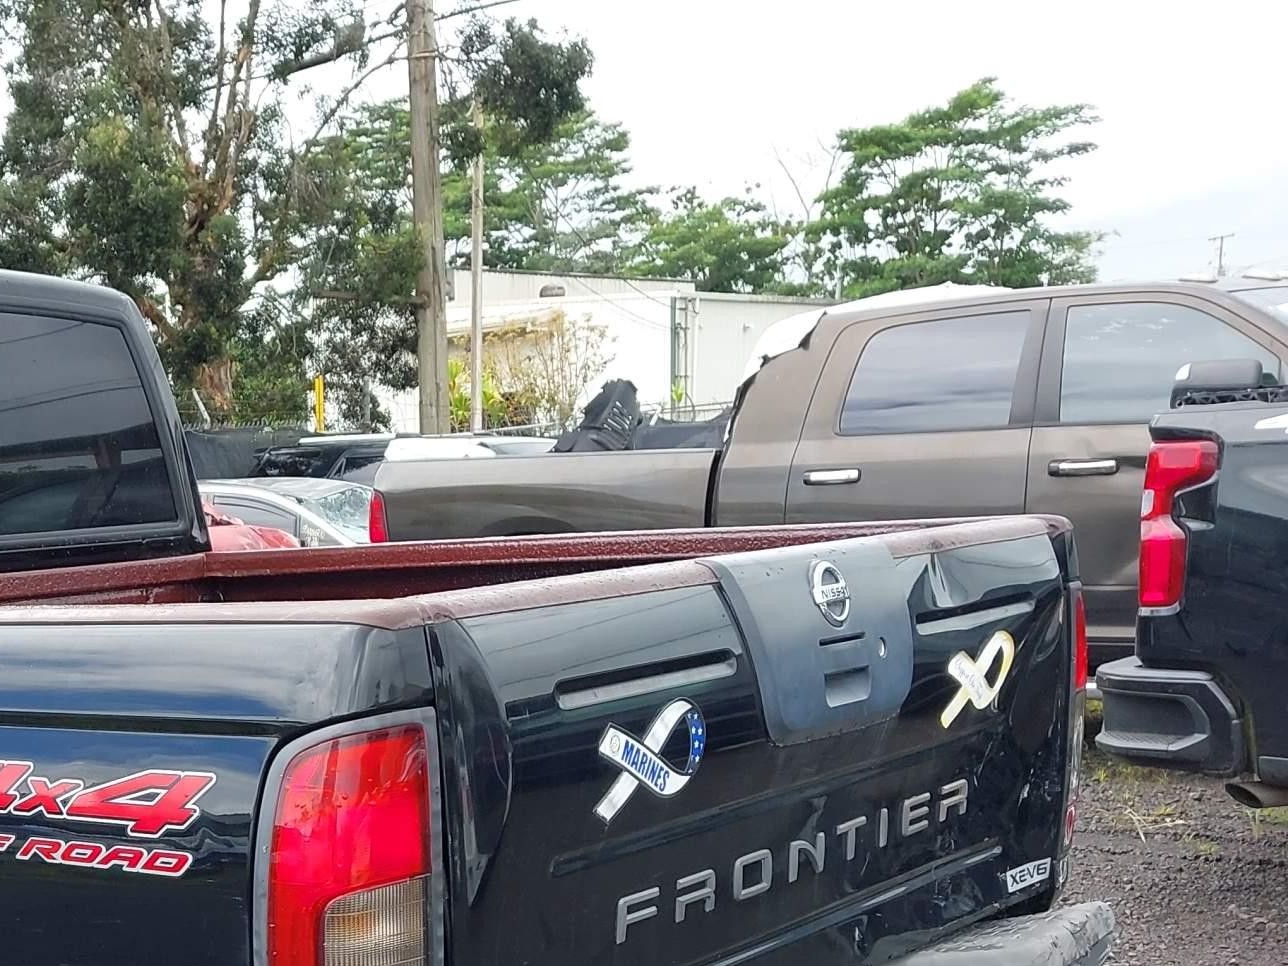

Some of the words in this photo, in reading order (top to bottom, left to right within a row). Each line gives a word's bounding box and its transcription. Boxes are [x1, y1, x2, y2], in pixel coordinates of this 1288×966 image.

[621, 739, 670, 792] MARINES
[16, 836, 193, 877] ROAD
[615, 778, 969, 945] FRONTIER
